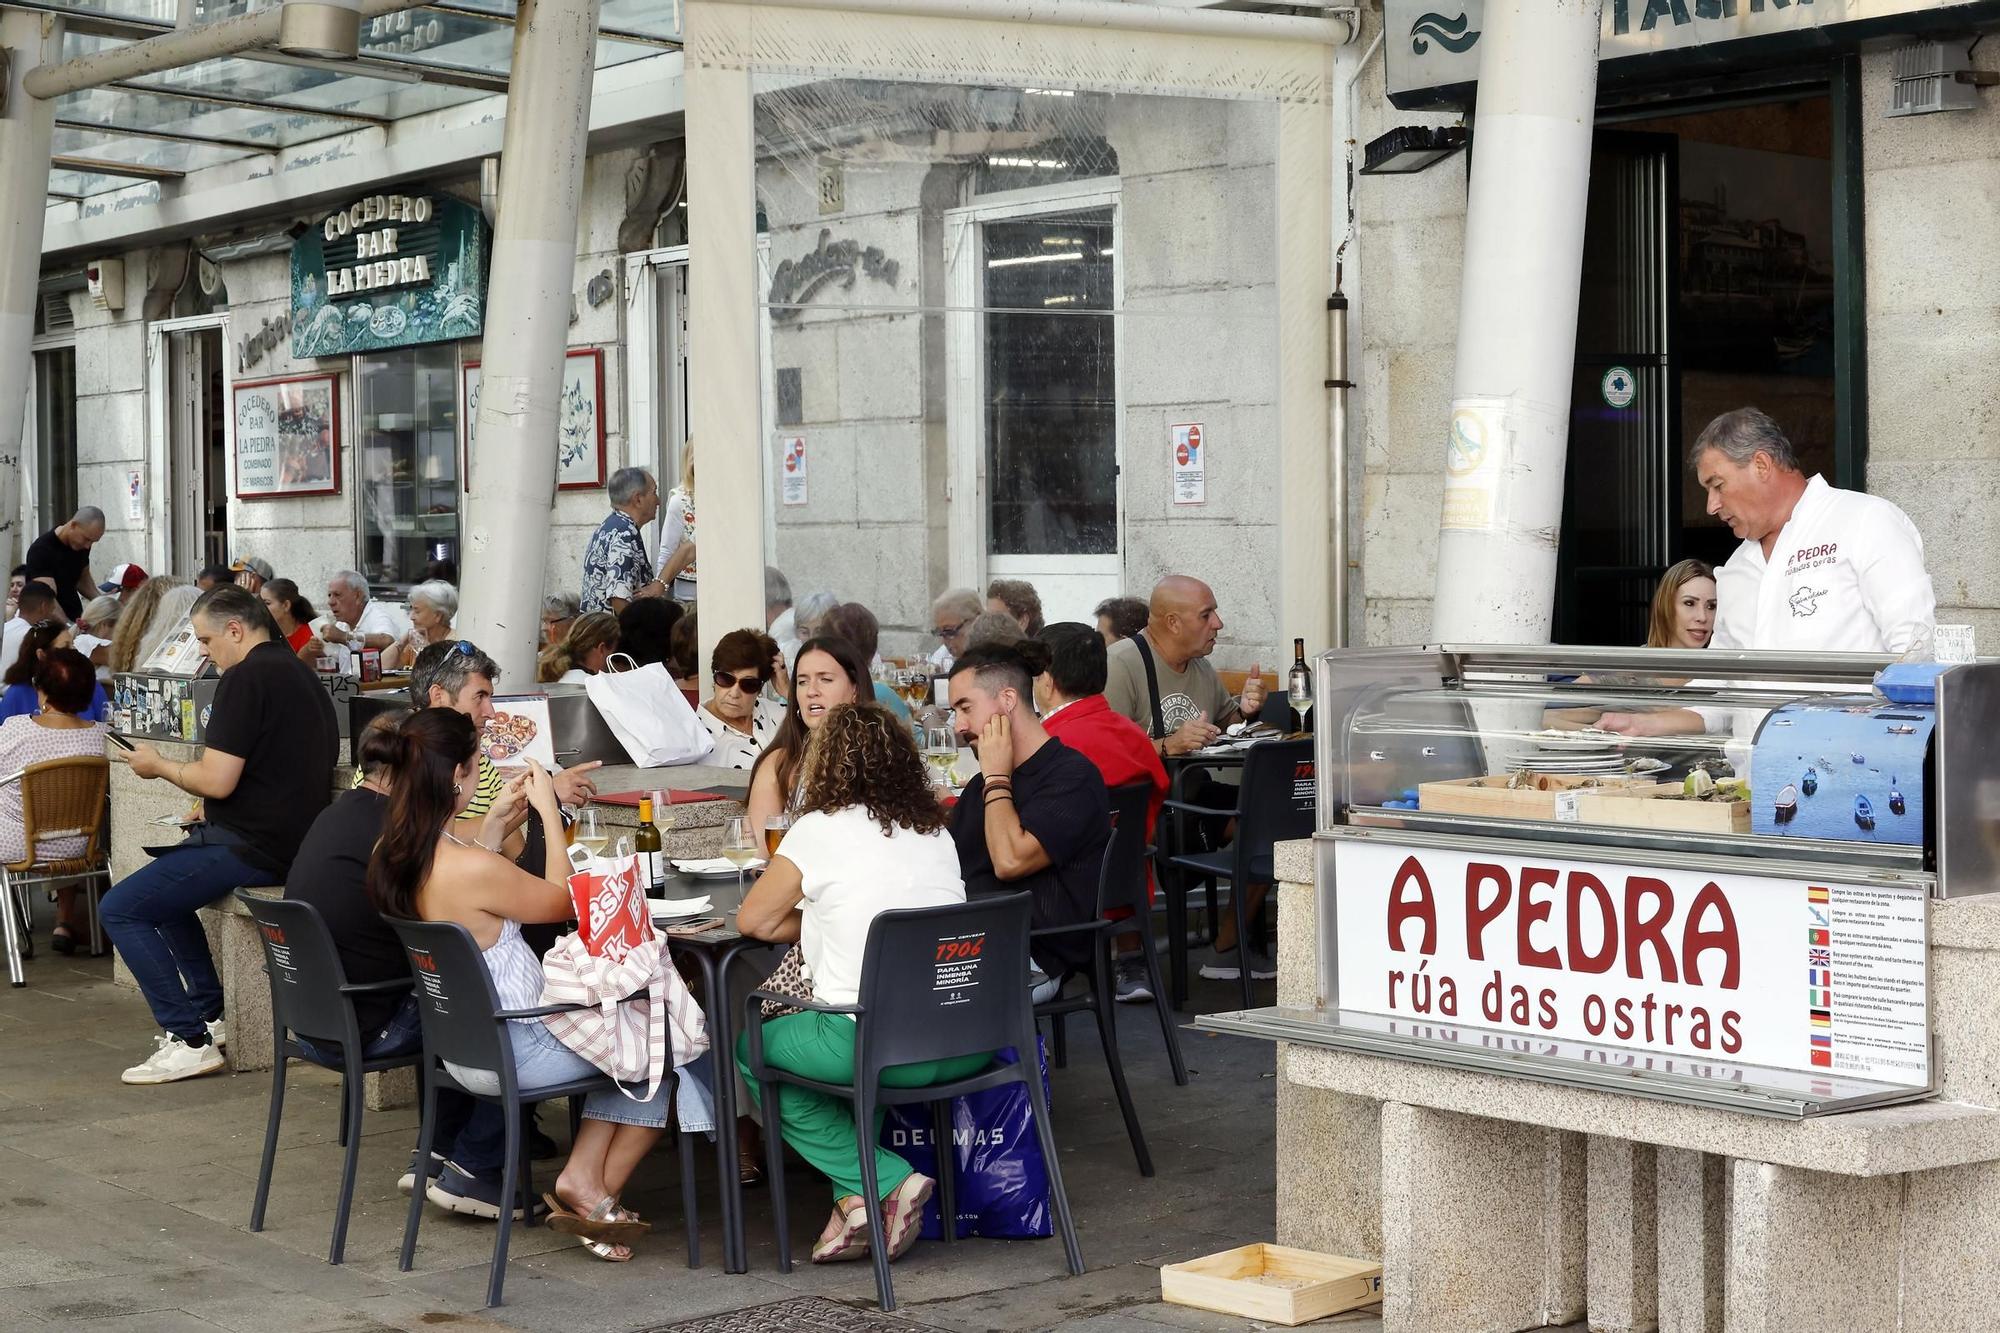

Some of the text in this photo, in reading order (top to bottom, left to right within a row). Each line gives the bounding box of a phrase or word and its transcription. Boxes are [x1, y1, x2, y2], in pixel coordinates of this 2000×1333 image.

[324, 194, 432, 241] COCEDERO
[356, 228, 398, 259] BAR
[326, 255, 430, 295] LA PIEDRA
[239, 394, 275, 426] COCEDERO
[249, 415, 264, 430] BAR
[239, 436, 275, 455] LA PIEDRA
[243, 457, 272, 470] COMBINADO
[250, 475, 274, 487] MARISCOS
[1797, 543, 1837, 562] PEDRA
[1387, 855, 1741, 990] A PEDRA
[936, 937, 985, 961] 1906
[936, 970, 972, 980] INMENSA
[937, 963, 978, 974] PARA UNA
[936, 976, 970, 986] MINORÍA
[1388, 959, 1743, 1054] rúa das ostras
[893, 1127, 1004, 1147] DEMAS
